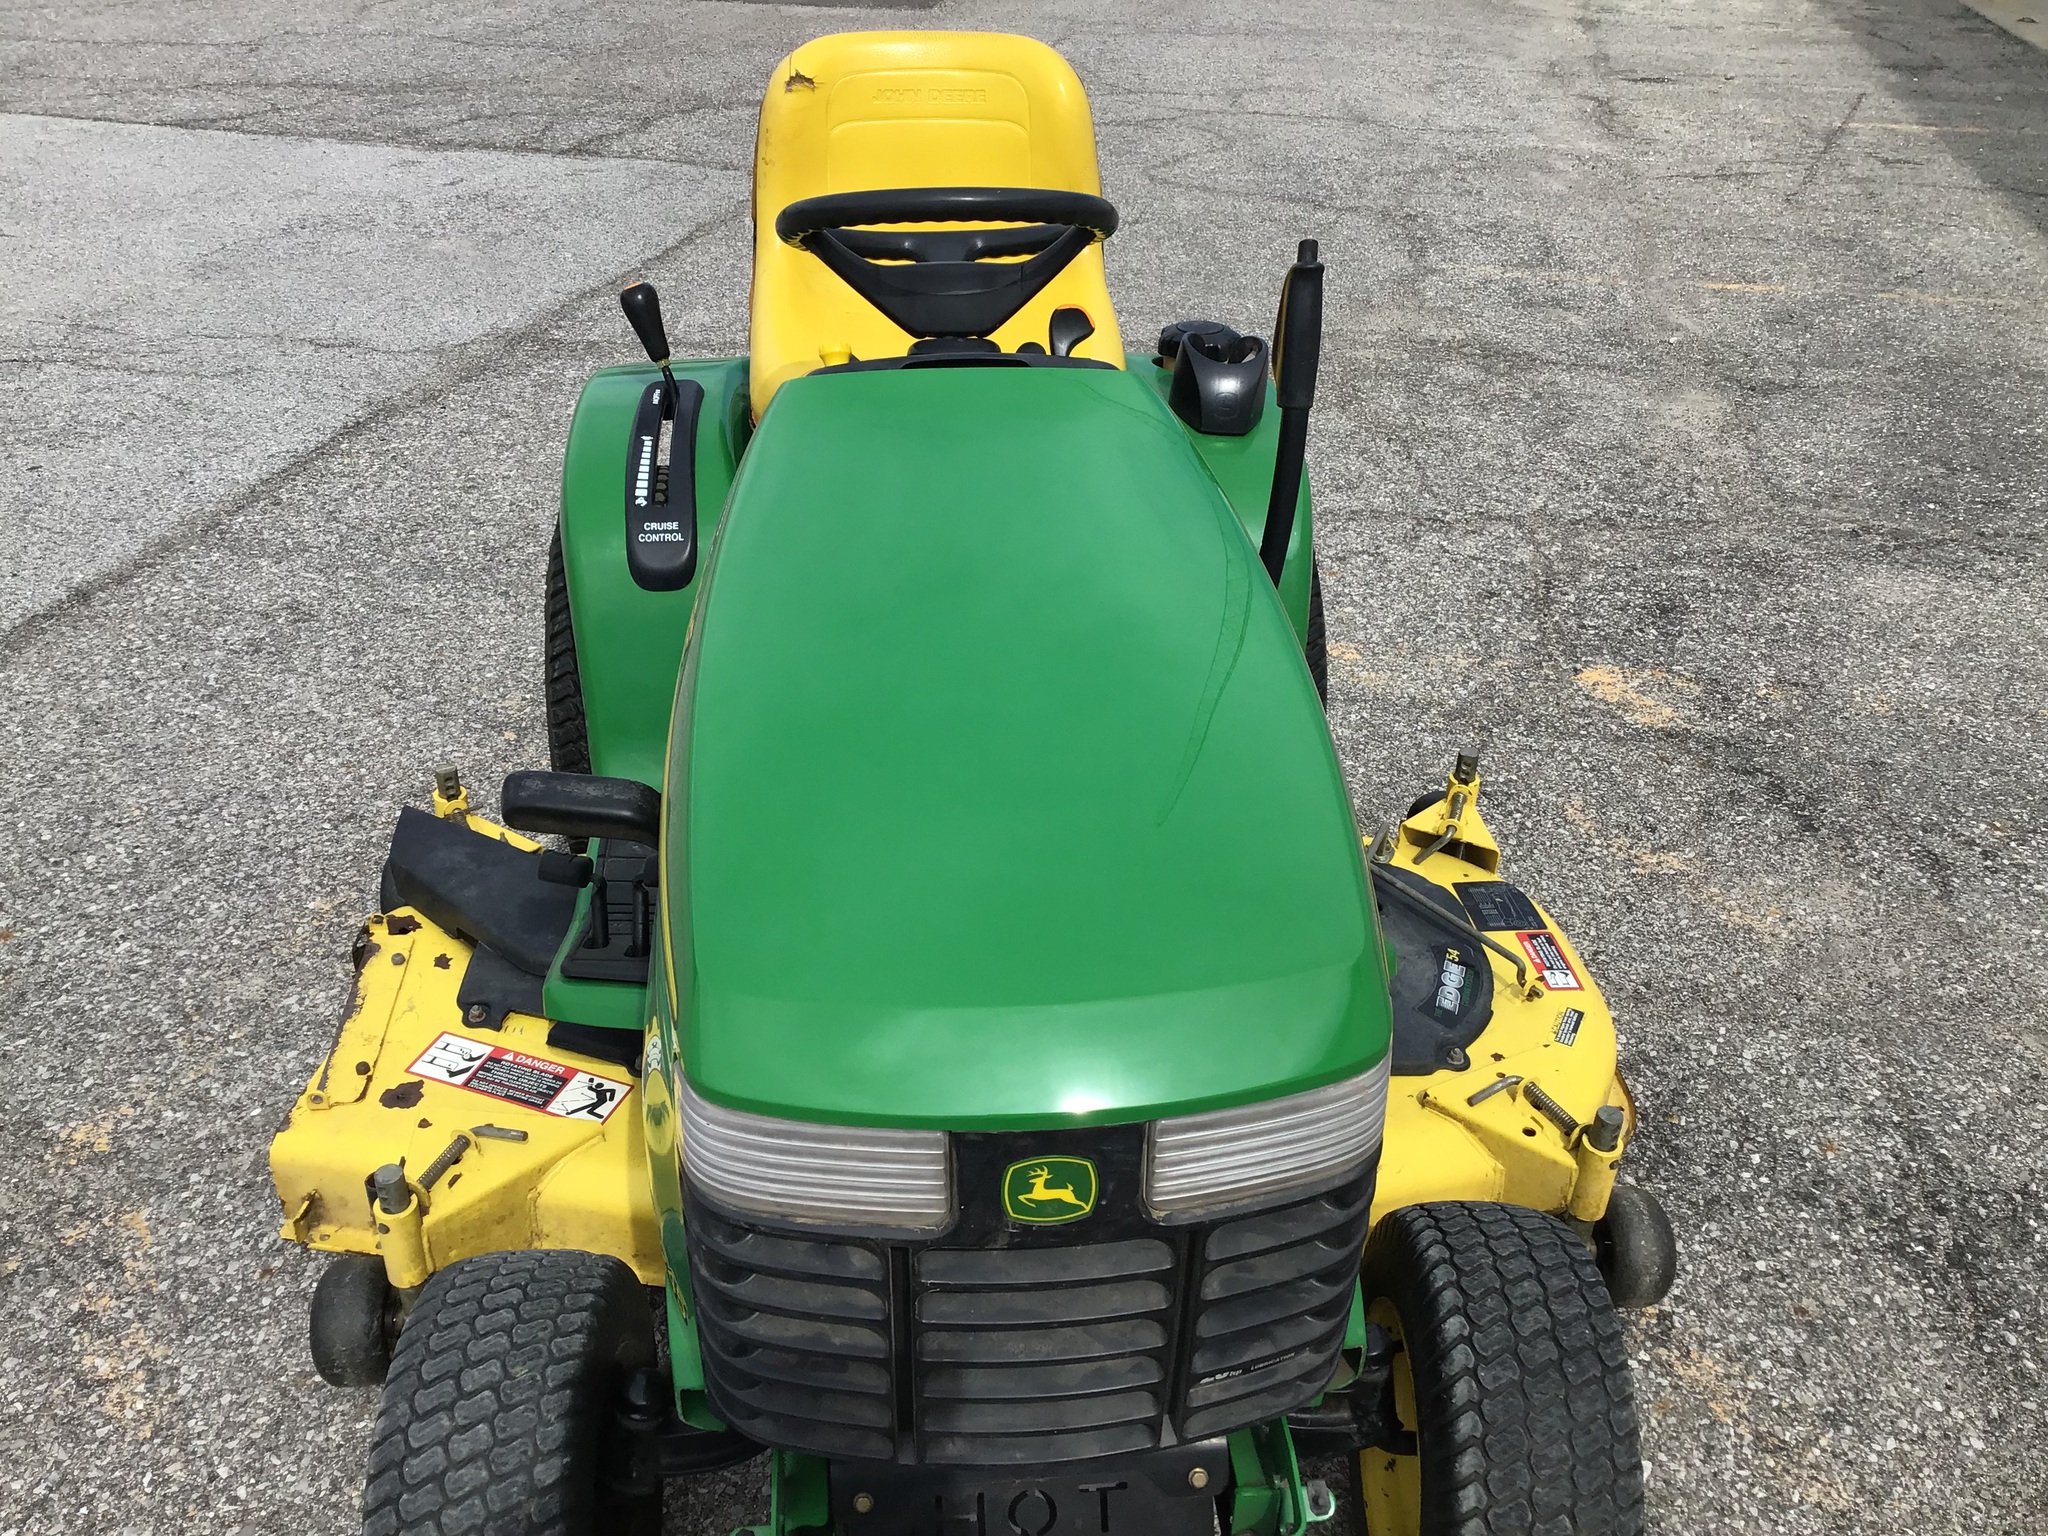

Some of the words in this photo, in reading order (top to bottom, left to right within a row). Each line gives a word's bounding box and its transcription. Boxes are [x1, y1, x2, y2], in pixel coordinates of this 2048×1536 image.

[872, 88, 921, 104] JOHN
[927, 88, 986, 104] DEERE
[643, 521, 679, 531] CRUISE
[638, 532, 685, 542] CONTROL
[1445, 947, 1460, 962] 54
[1435, 960, 1466, 1016] EDGE
[515, 1055, 565, 1075] DANGER
[934, 1481, 1128, 1536] HOT
